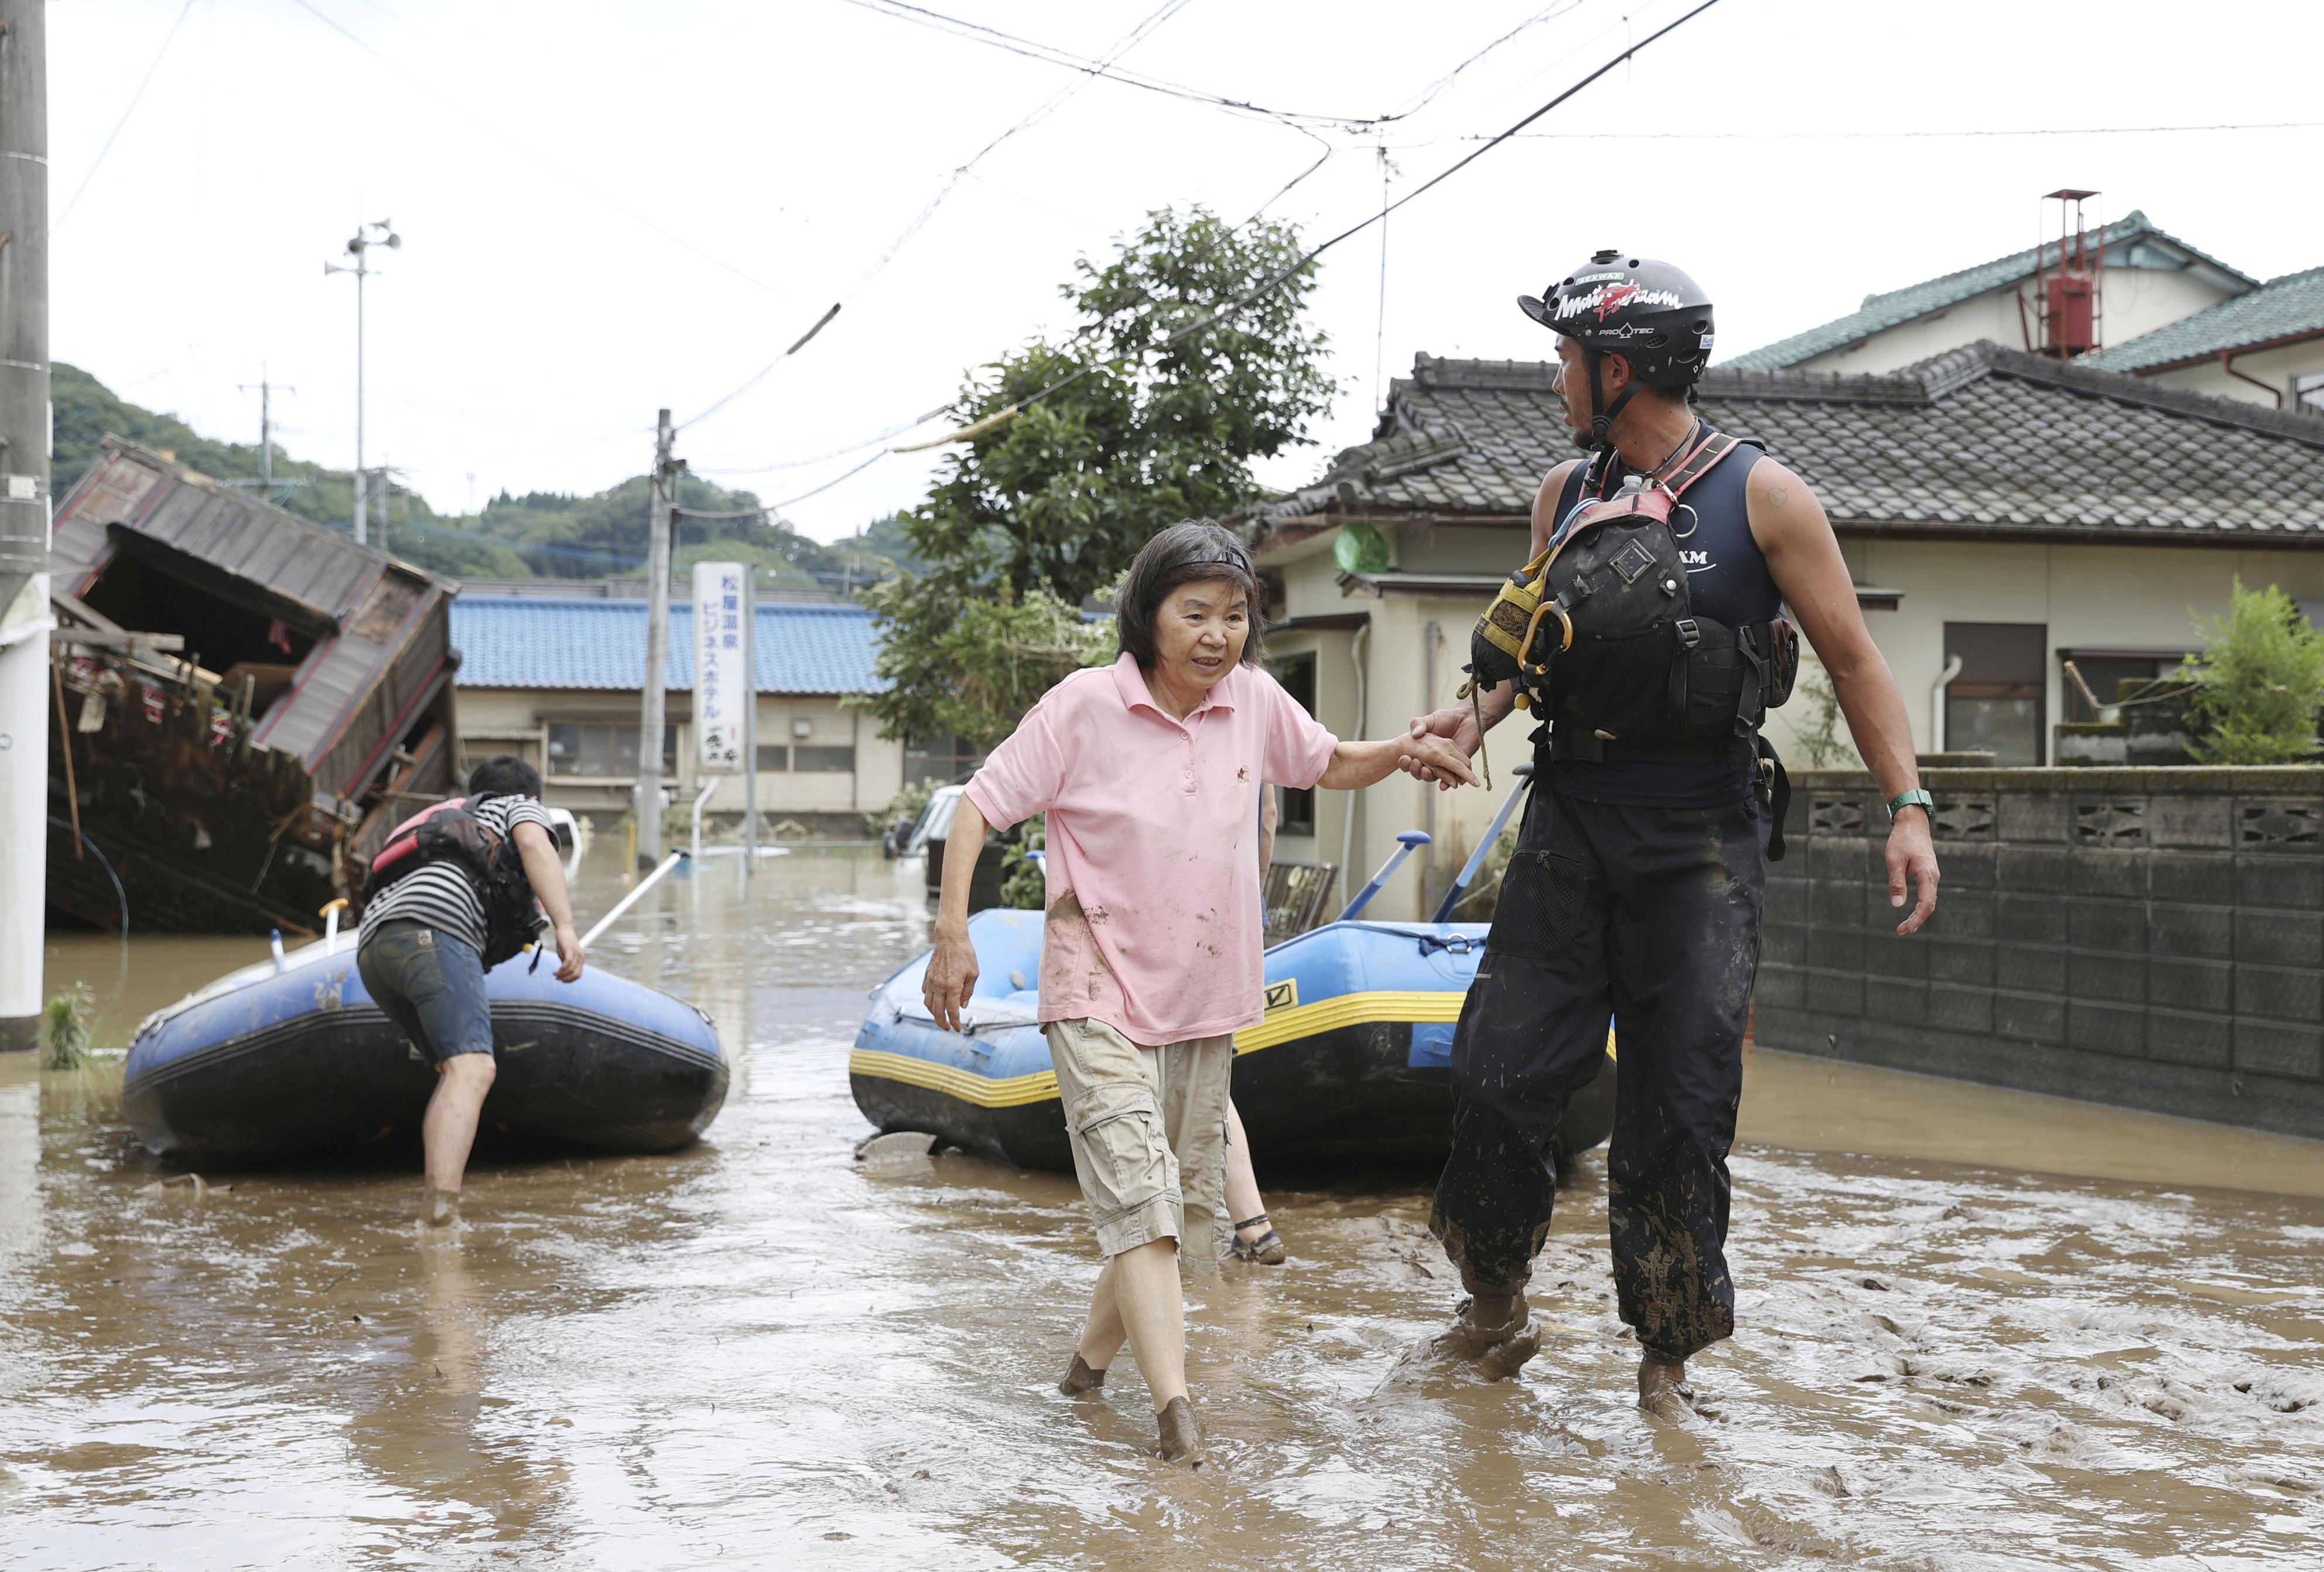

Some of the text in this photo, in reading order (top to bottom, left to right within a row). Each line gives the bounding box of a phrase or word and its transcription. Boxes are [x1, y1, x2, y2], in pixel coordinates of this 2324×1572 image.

[1577, 273, 1621, 284] SEXWAX
[722, 575, 739, 650] 松屋温泉
[703, 602, 720, 720] ビジネスホテル
